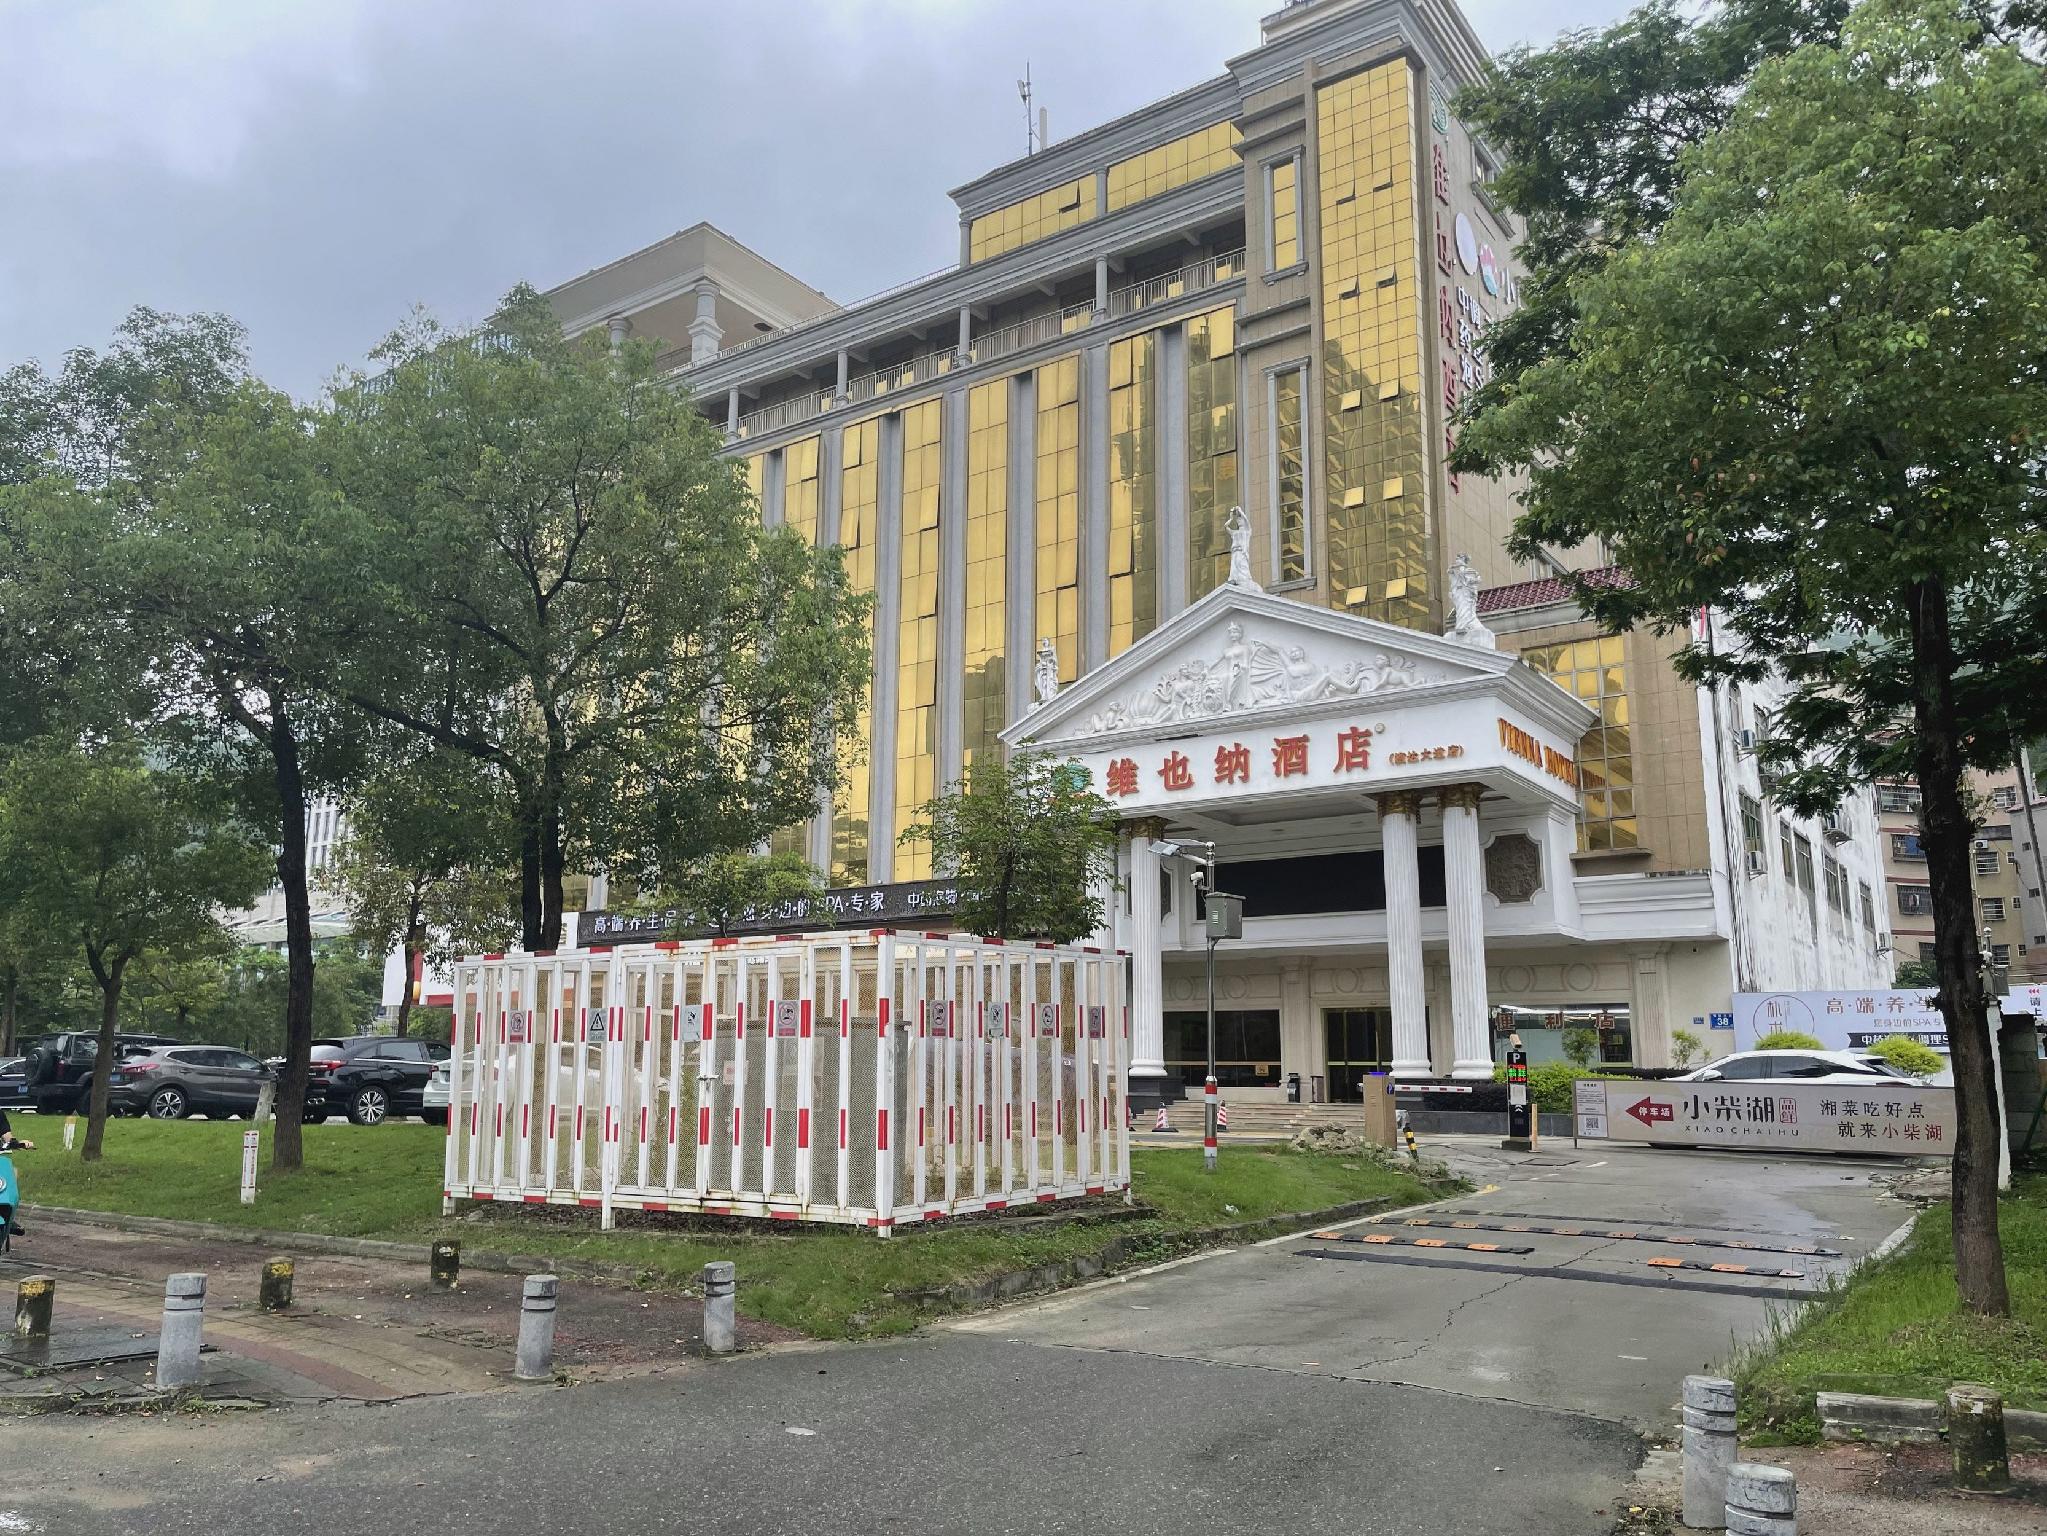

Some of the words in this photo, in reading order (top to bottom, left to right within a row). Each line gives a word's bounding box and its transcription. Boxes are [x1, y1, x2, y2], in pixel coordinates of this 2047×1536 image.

[1106, 726, 1374, 797] 维也纳酒店
[1717, 1017, 1729, 1026] 38
[1513, 1053, 1521, 1063] P
[1638, 1106, 1670, 1117] 停车场
[1684, 1094, 1775, 1123] 小柴湖
[1820, 1099, 1925, 1119] 湘菜吃好点
[1838, 1120, 1942, 1141] 就来小柴湖
